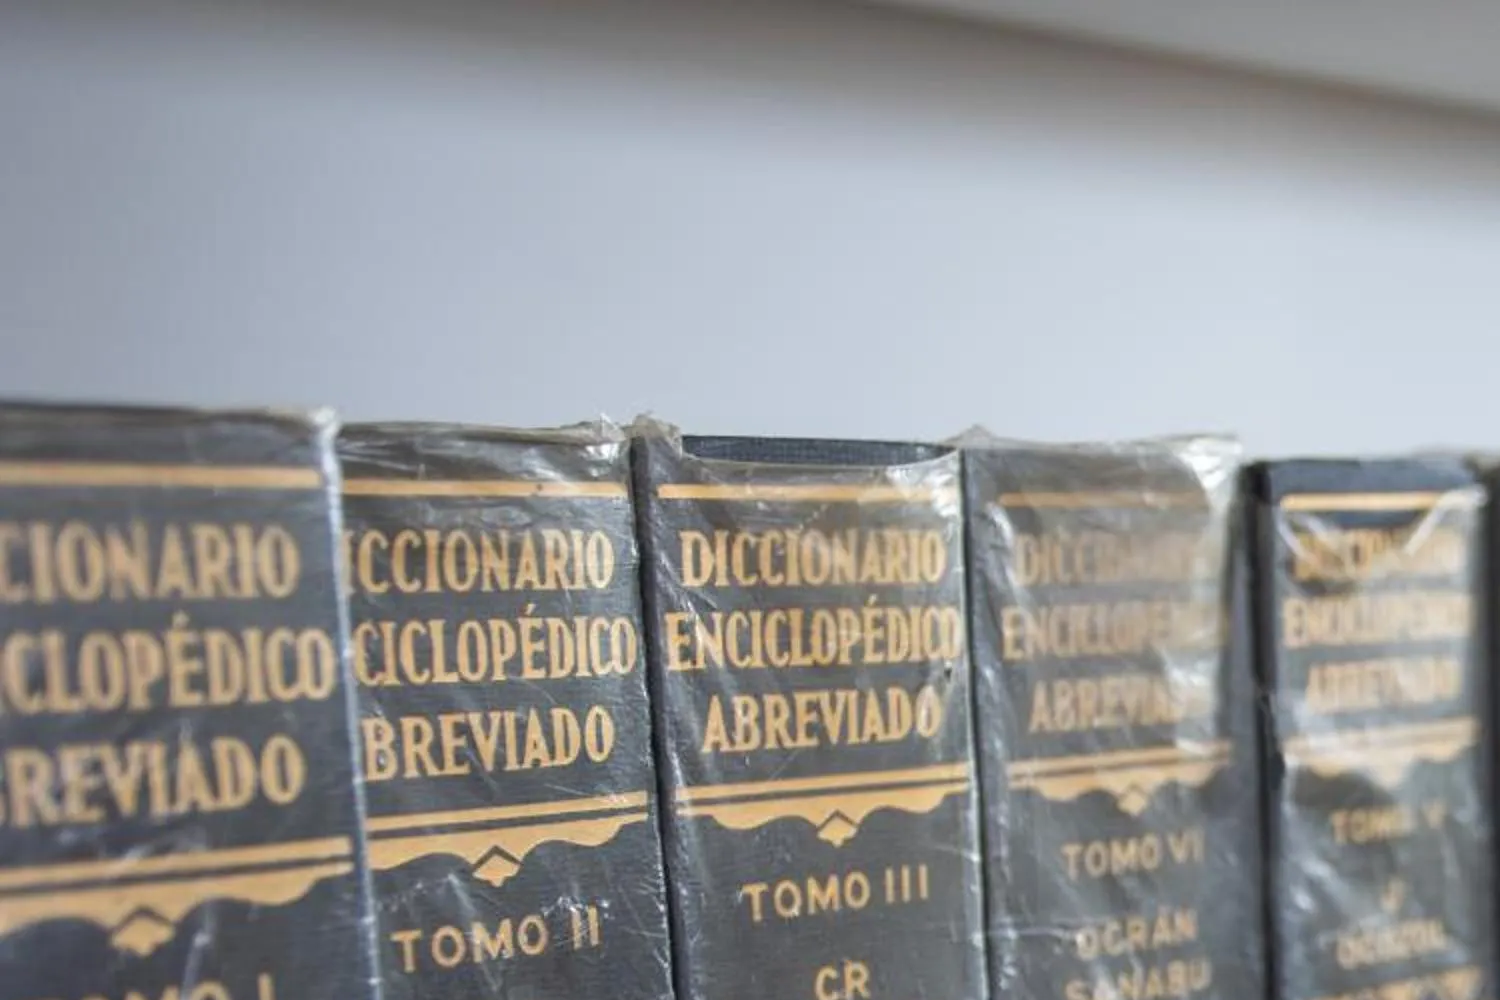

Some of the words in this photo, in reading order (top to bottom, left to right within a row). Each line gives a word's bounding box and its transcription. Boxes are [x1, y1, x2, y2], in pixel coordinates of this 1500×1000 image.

[679, 528, 947, 587] DICCIONARIO
[664, 594, 961, 671] ENCICLOPÉDICO
[701, 685, 942, 753] ABREVIADO
[0, 735, 304, 829] REVIADO
[1061, 833, 1162, 881] TOMO
[1168, 825, 1206, 865] VI
[741, 871, 870, 922] TOMO
[884, 864, 929, 903] III
[390, 915, 548, 973] TOMO
[571, 907, 599, 950] II
